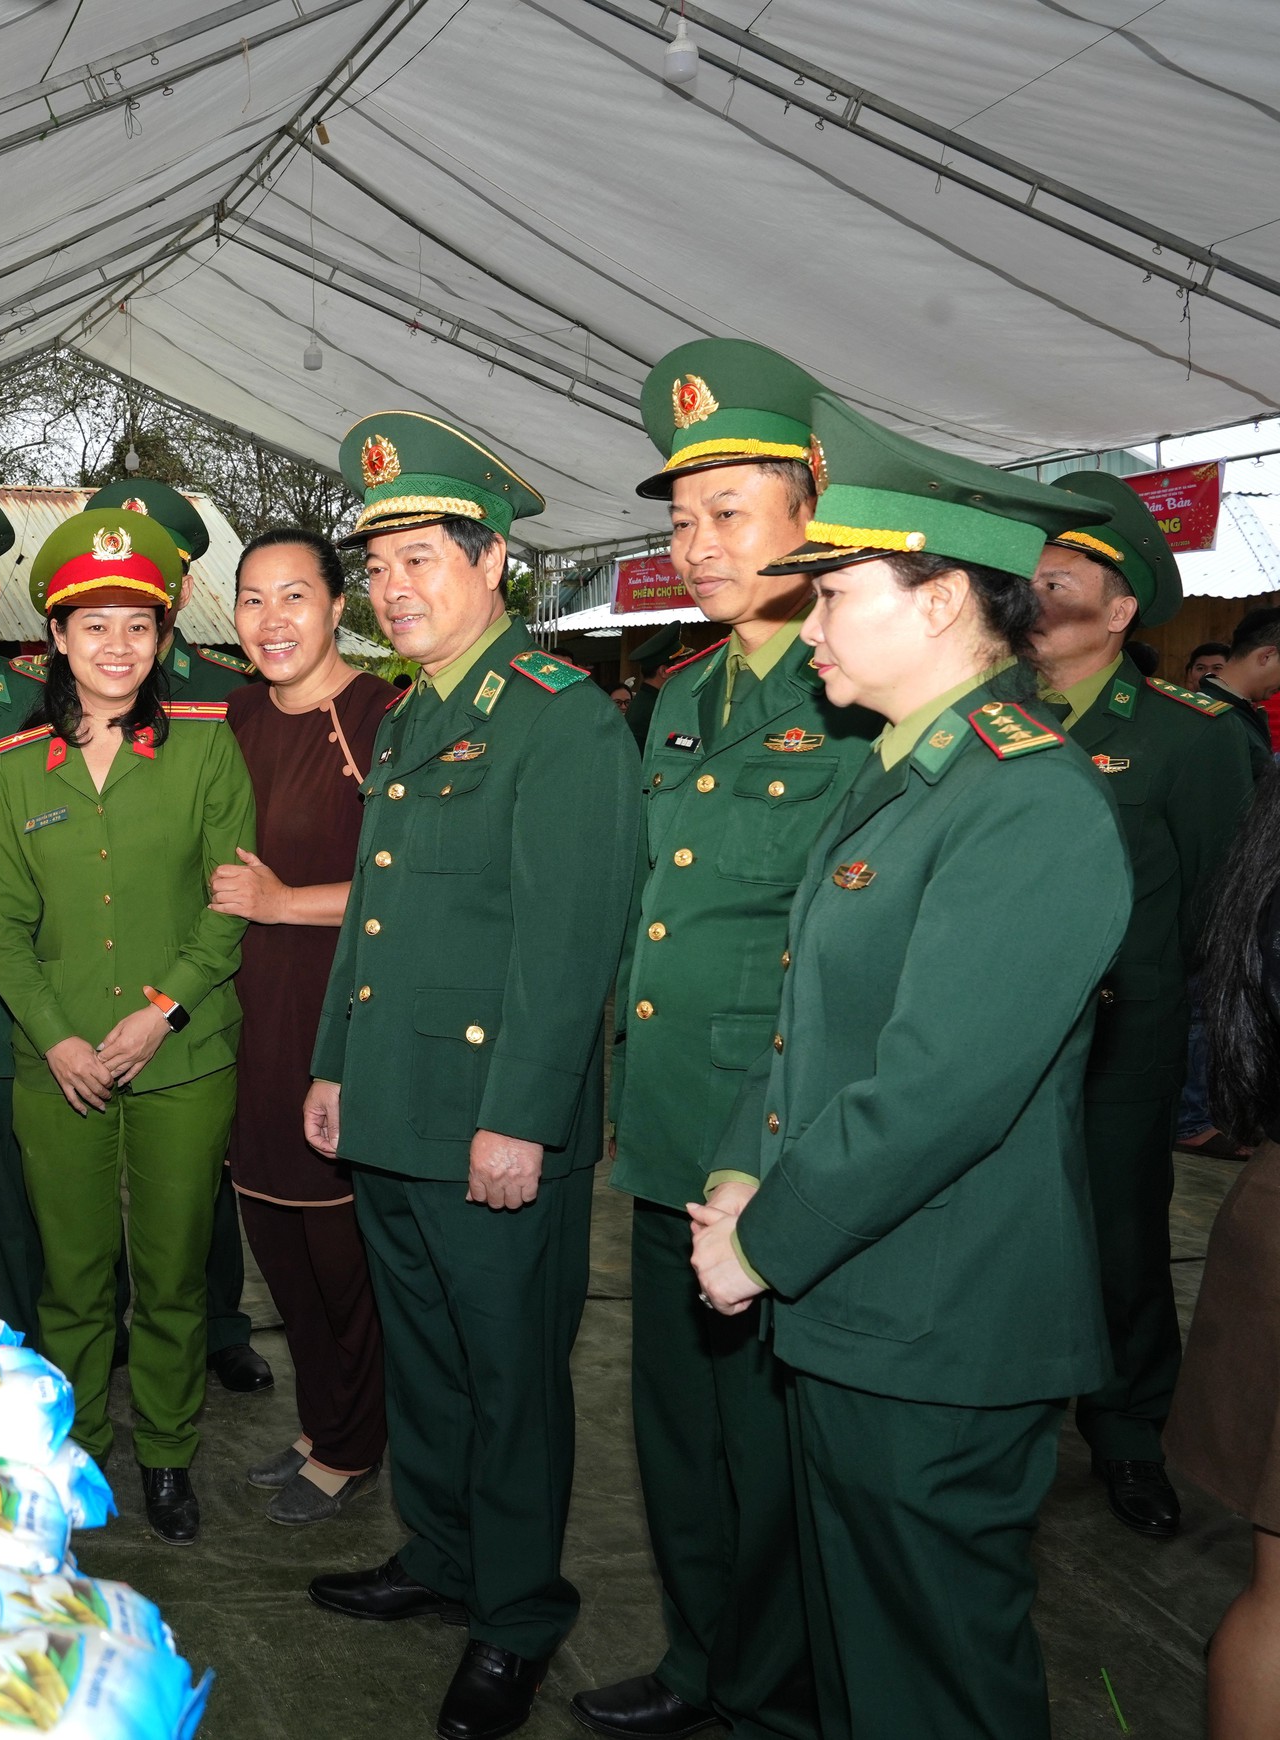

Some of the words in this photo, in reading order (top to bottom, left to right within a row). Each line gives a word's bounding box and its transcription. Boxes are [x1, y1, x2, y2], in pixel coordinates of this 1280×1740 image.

[1165, 497, 1192, 510] Bản
[1158, 517, 1180, 533] NG
[656, 585, 672, 599] CHỢ
[673, 582, 687, 596] TẾT
